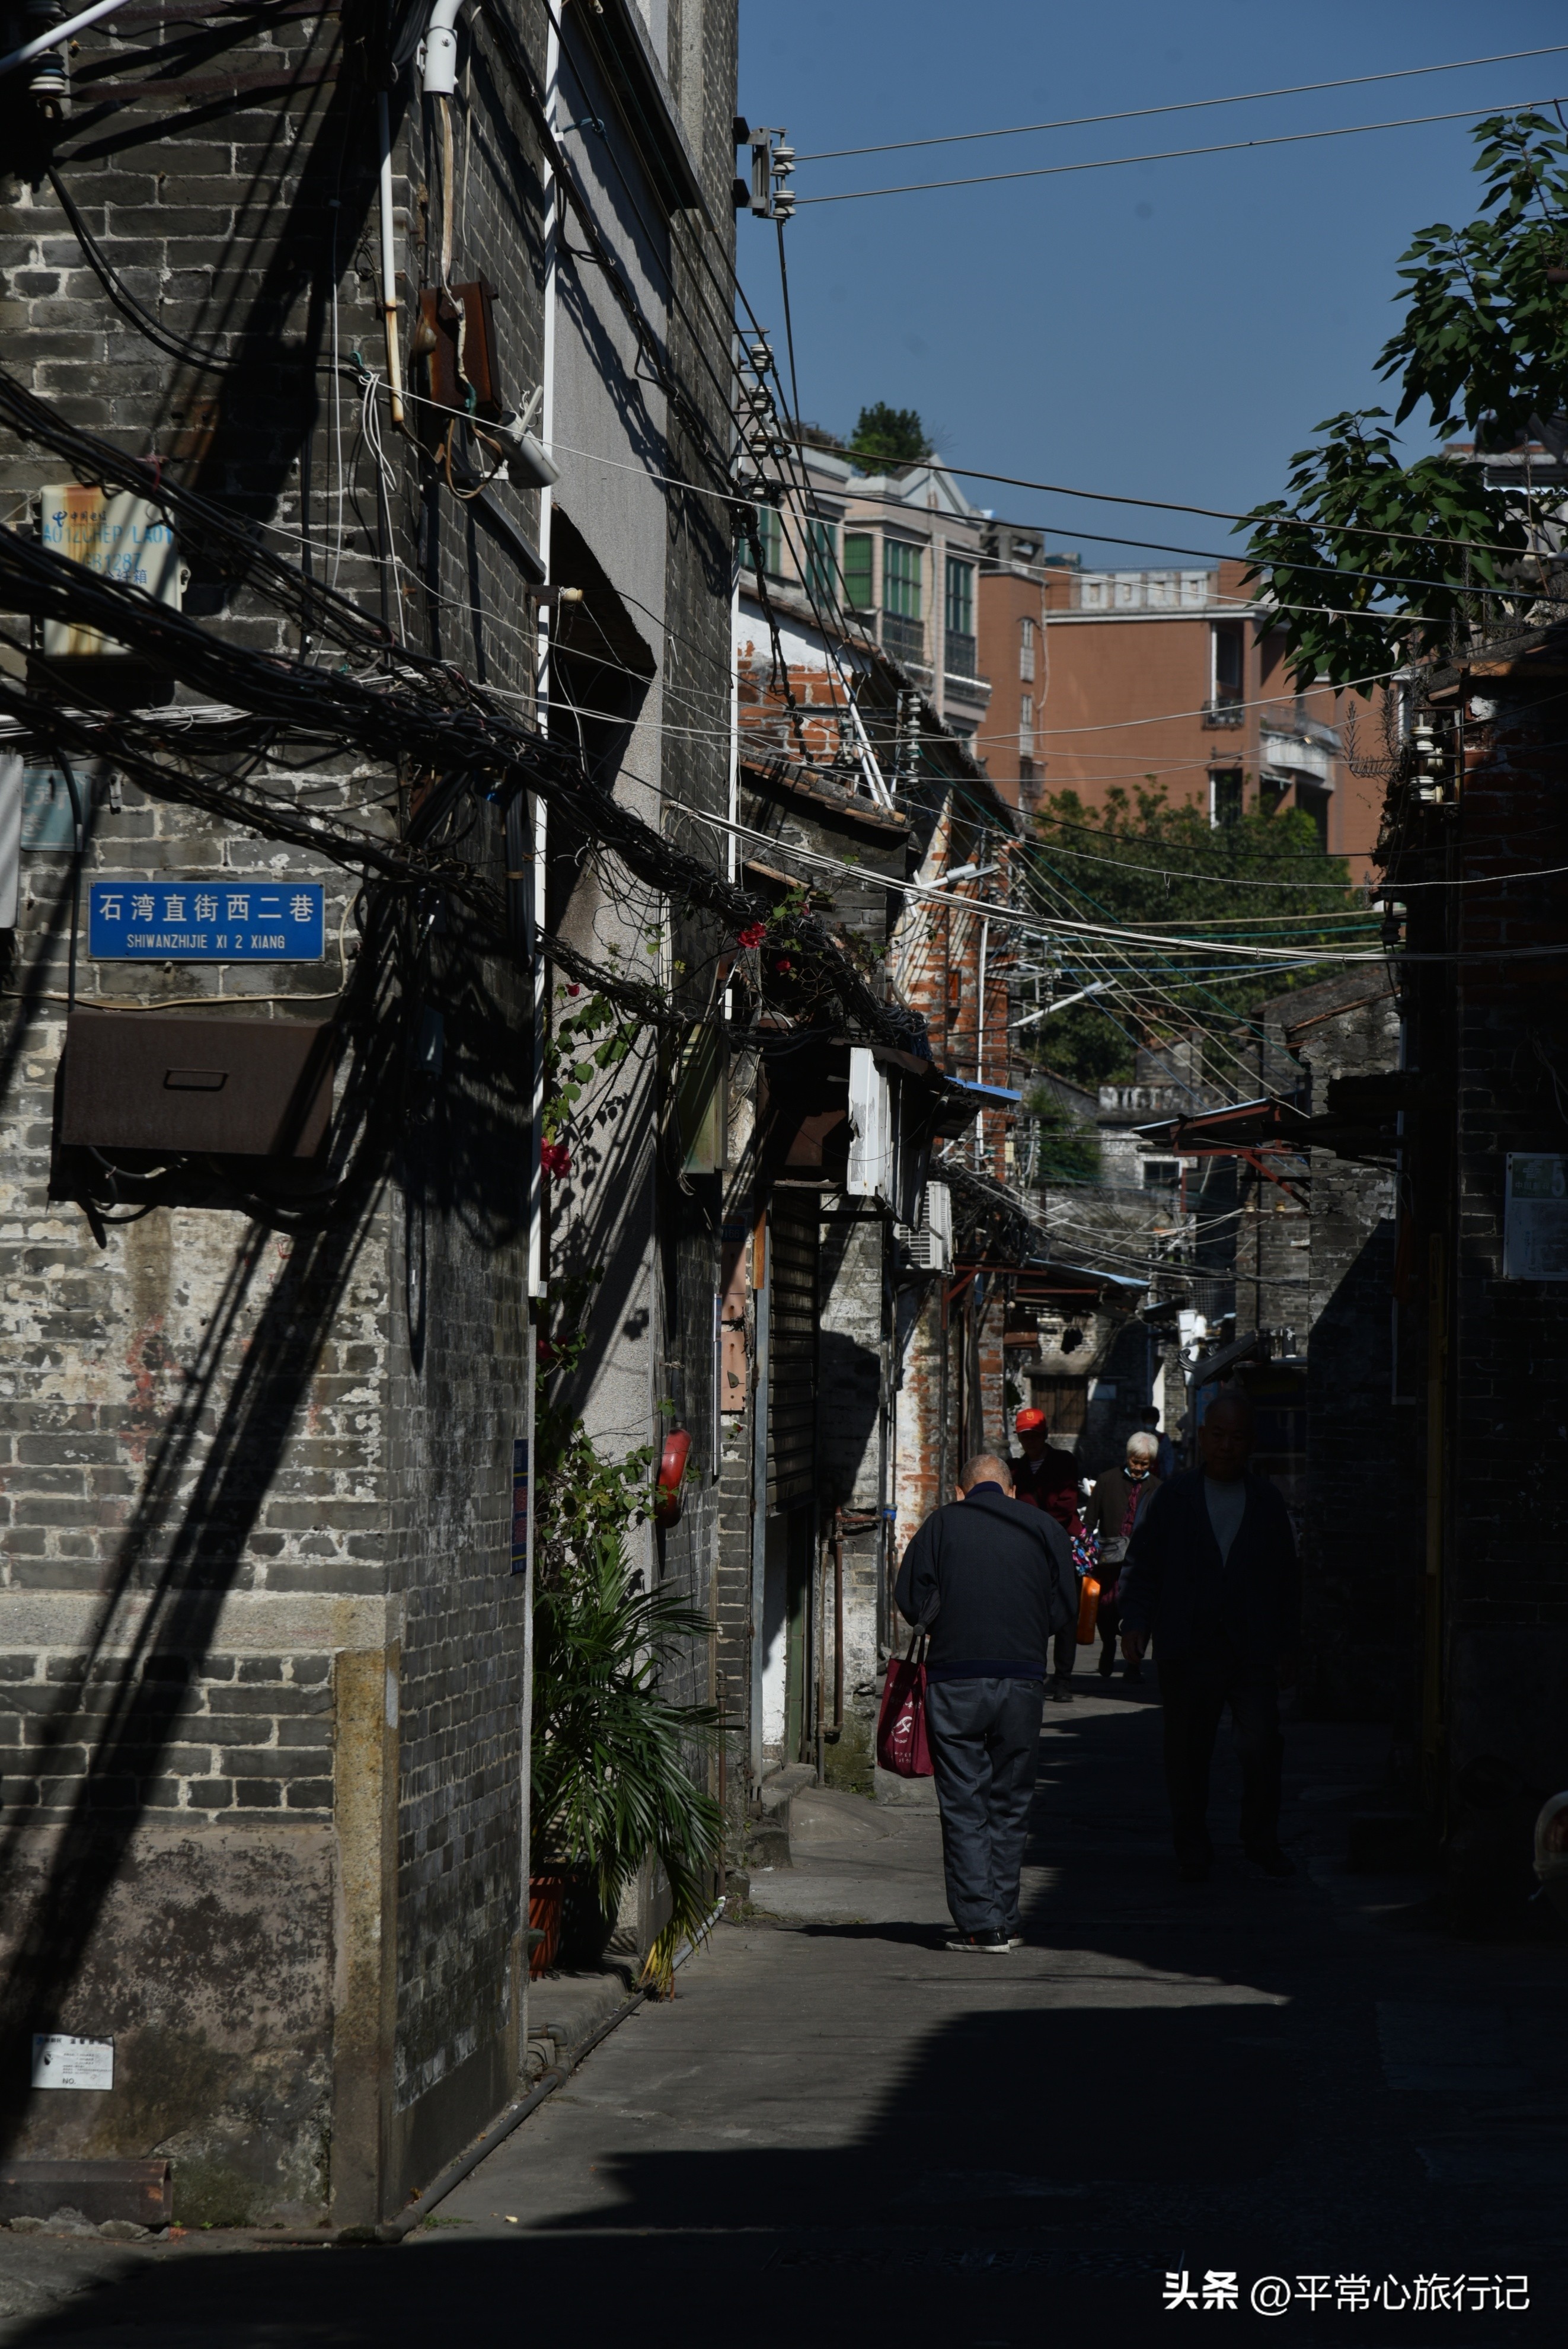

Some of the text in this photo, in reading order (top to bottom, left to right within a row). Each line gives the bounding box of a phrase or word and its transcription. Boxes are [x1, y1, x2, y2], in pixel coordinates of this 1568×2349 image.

[71, 511, 107, 521] 中国电信
[99, 893, 314, 923] 石湾直街西二巷
[126, 934, 286, 949] SHIWANZHIJIE XI 2 XIANG
